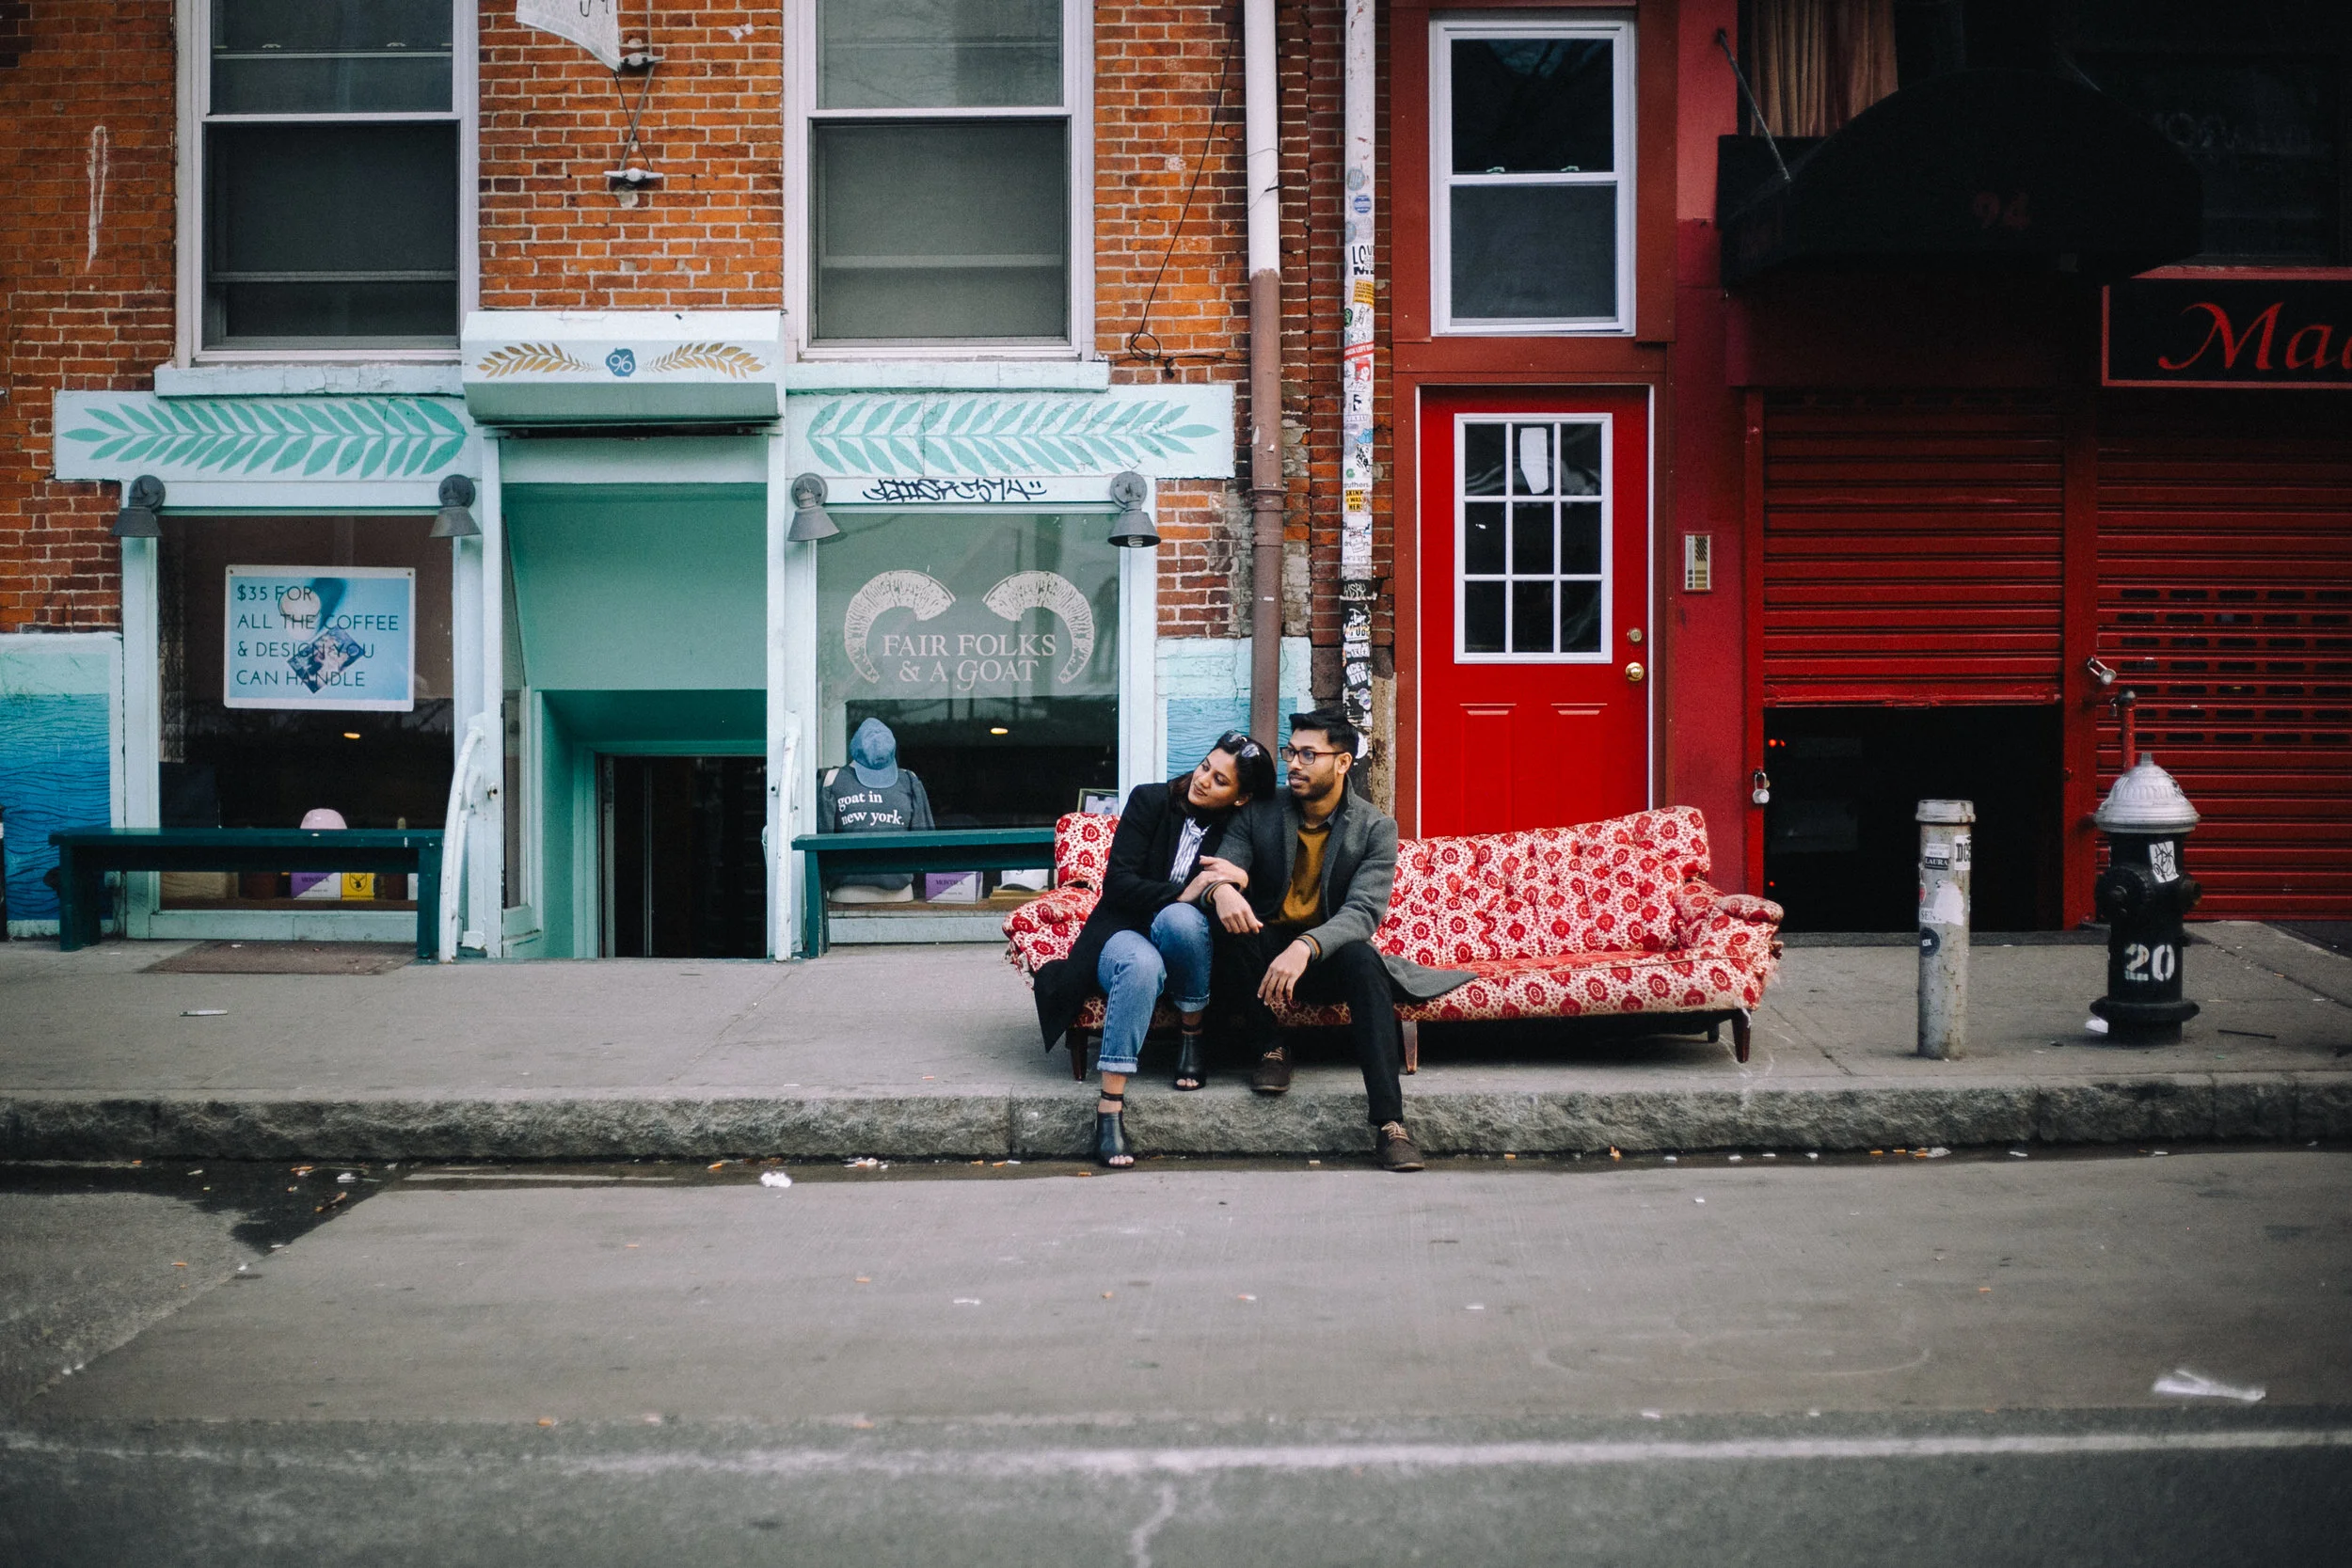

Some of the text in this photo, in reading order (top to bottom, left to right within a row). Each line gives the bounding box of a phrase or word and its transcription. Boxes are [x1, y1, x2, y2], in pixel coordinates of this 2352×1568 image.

[609, 354, 633, 372] 96
[237, 583, 312, 603] $35 FOR
[237, 613, 399, 631] ALL THE COFFEE
[237, 641, 374, 659] & DESIGN YOU
[882, 634, 1057, 657] FAIR FOLKS
[236, 669, 366, 688] CAN HANDLE
[898, 659, 1040, 691] & A GOAT
[837, 791, 882, 812] goat in
[841, 810, 904, 826] new york.
[1925, 857, 1949, 865] LAURA
[2124, 943, 2175, 982] 20
